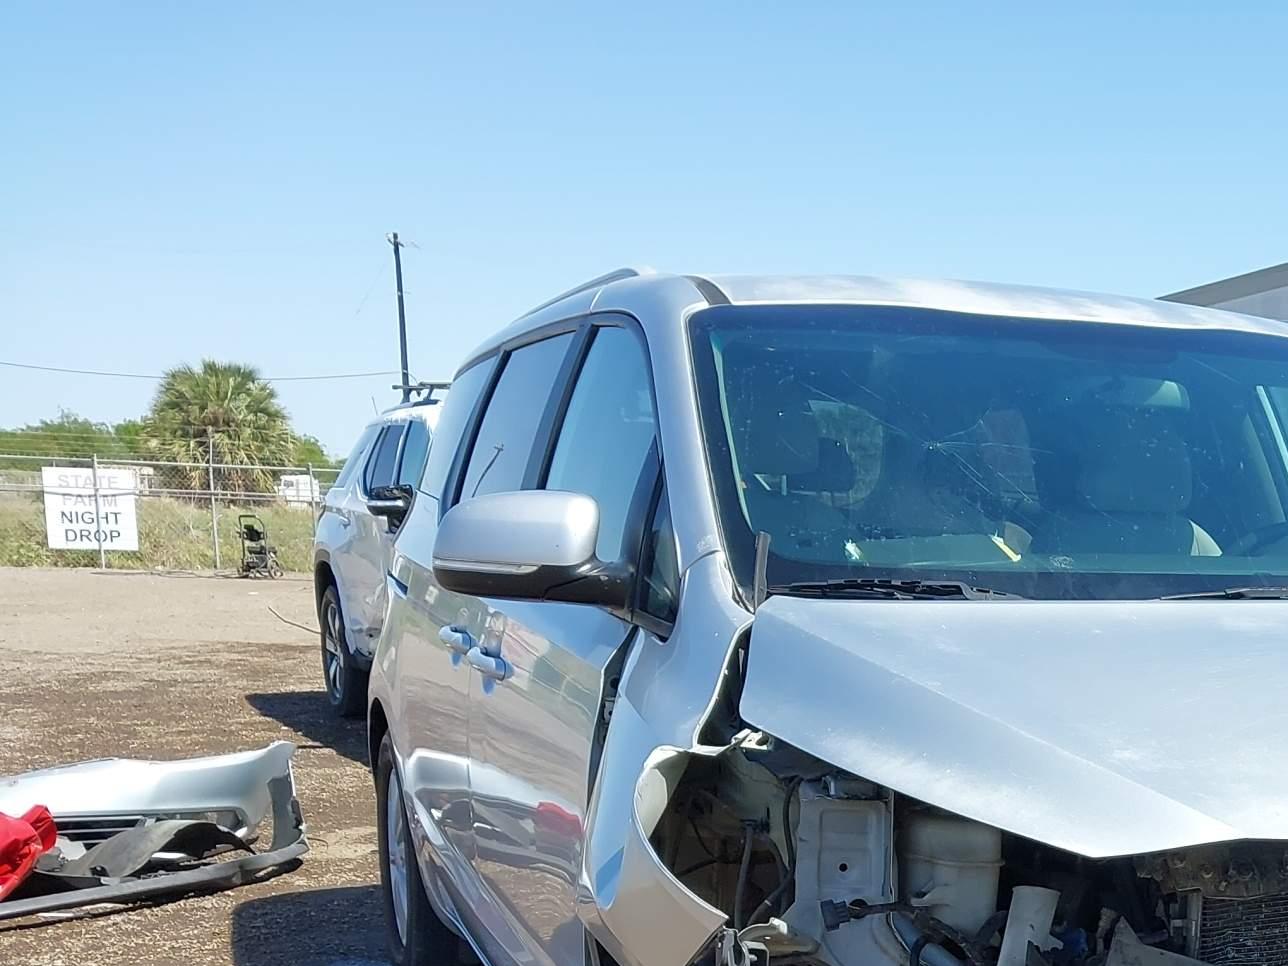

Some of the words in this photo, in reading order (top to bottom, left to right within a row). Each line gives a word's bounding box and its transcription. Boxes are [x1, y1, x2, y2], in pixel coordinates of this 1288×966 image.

[57, 474, 119, 489] STATE
[60, 510, 122, 525] NIGHT
[64, 528, 121, 543] DROP
